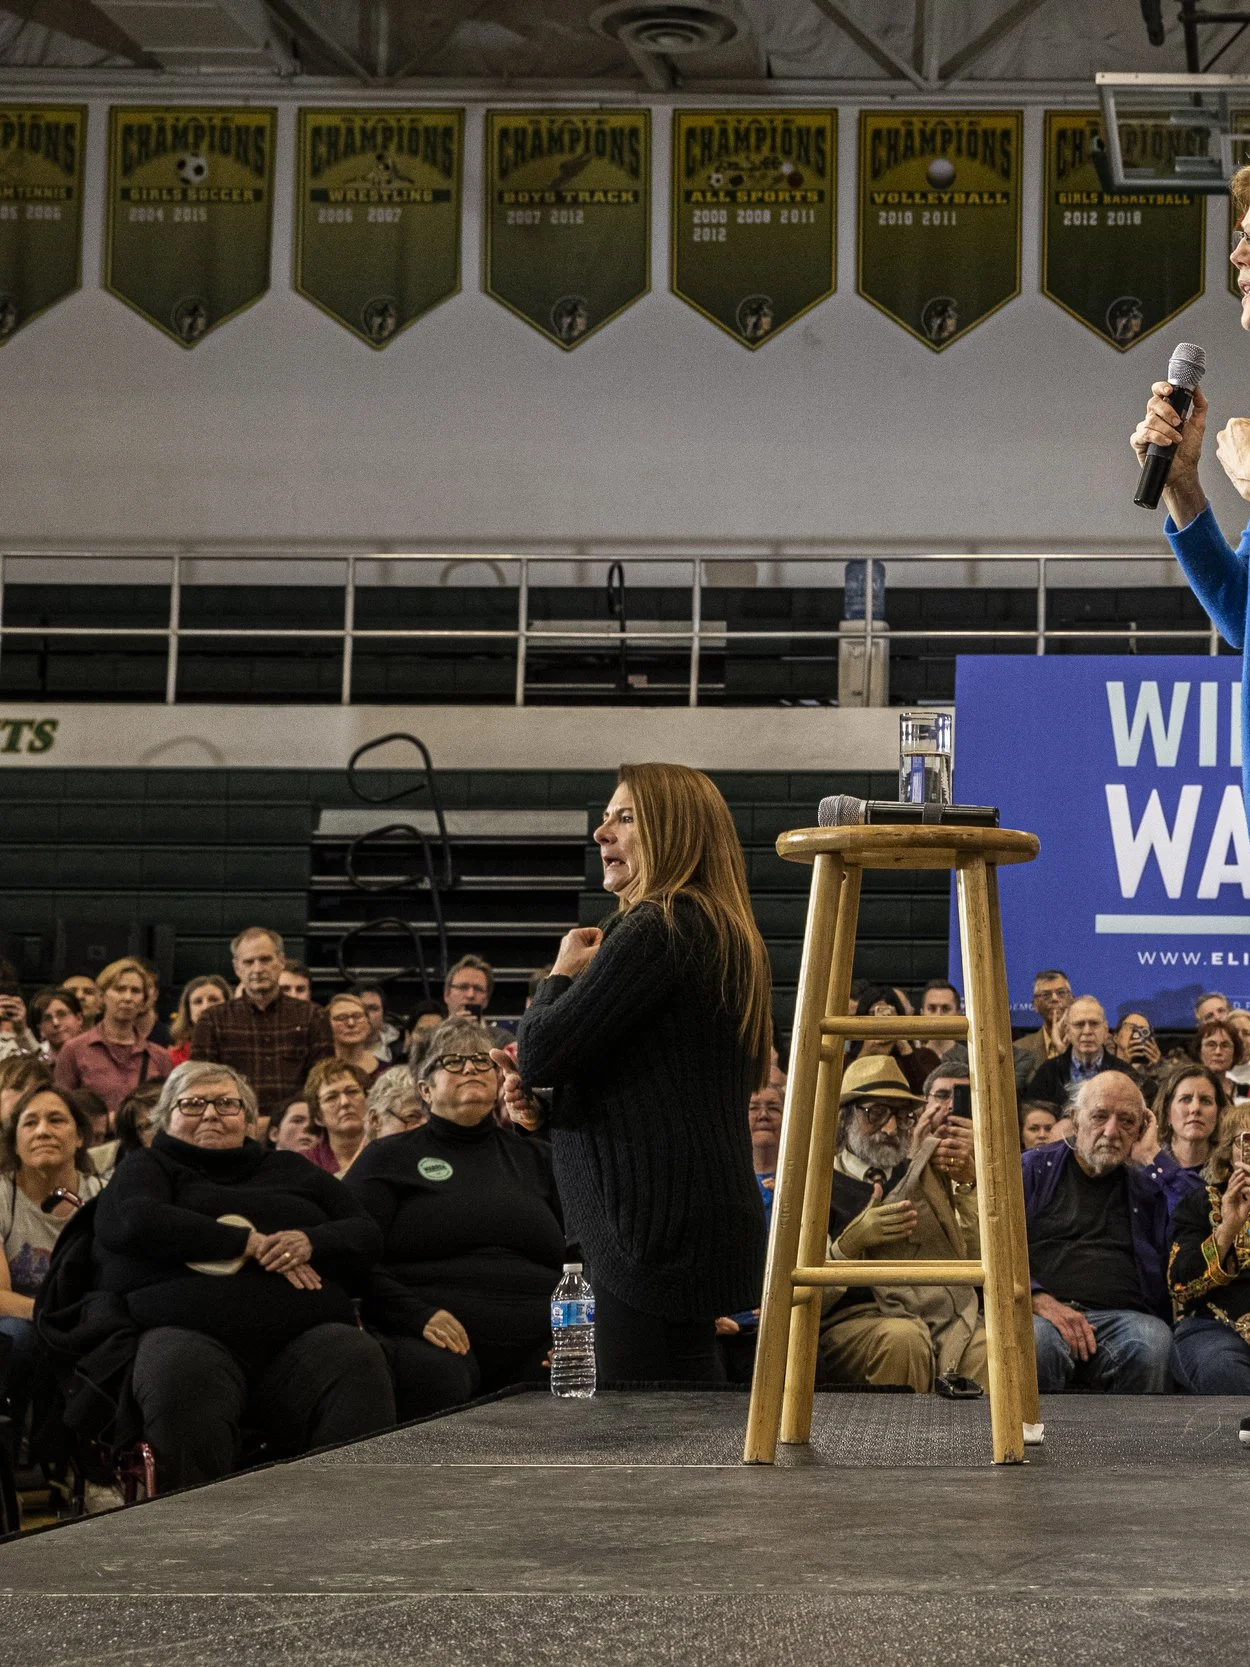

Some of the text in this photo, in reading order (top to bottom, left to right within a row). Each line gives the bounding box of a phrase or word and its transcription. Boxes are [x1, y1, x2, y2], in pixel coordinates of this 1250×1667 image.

[122, 124, 266, 178] CHAMPIONS
[311, 125, 454, 181] CHAMPIONS
[499, 127, 641, 181] CHAMPIONS
[685, 127, 826, 181] CHAMPIONS
[871, 129, 1012, 182] CHAMPIONS
[130, 188, 254, 202] GIRLS SOCCER
[328, 189, 434, 203] WRESTLING
[503, 191, 634, 204] BOYS TRACK
[690, 190, 819, 203] ALL SPORTS
[873, 192, 1008, 205] VOLLEYBALL
[1058, 192, 1099, 205] GIRLS
[173, 207, 207, 222] 2015
[367, 207, 402, 223] 2007
[506, 210, 585, 225] 2007 2012
[779, 209, 816, 225] 2011
[921, 210, 958, 226] 2011
[1063, 210, 1098, 226] 2012
[692, 227, 728, 243] 2012
